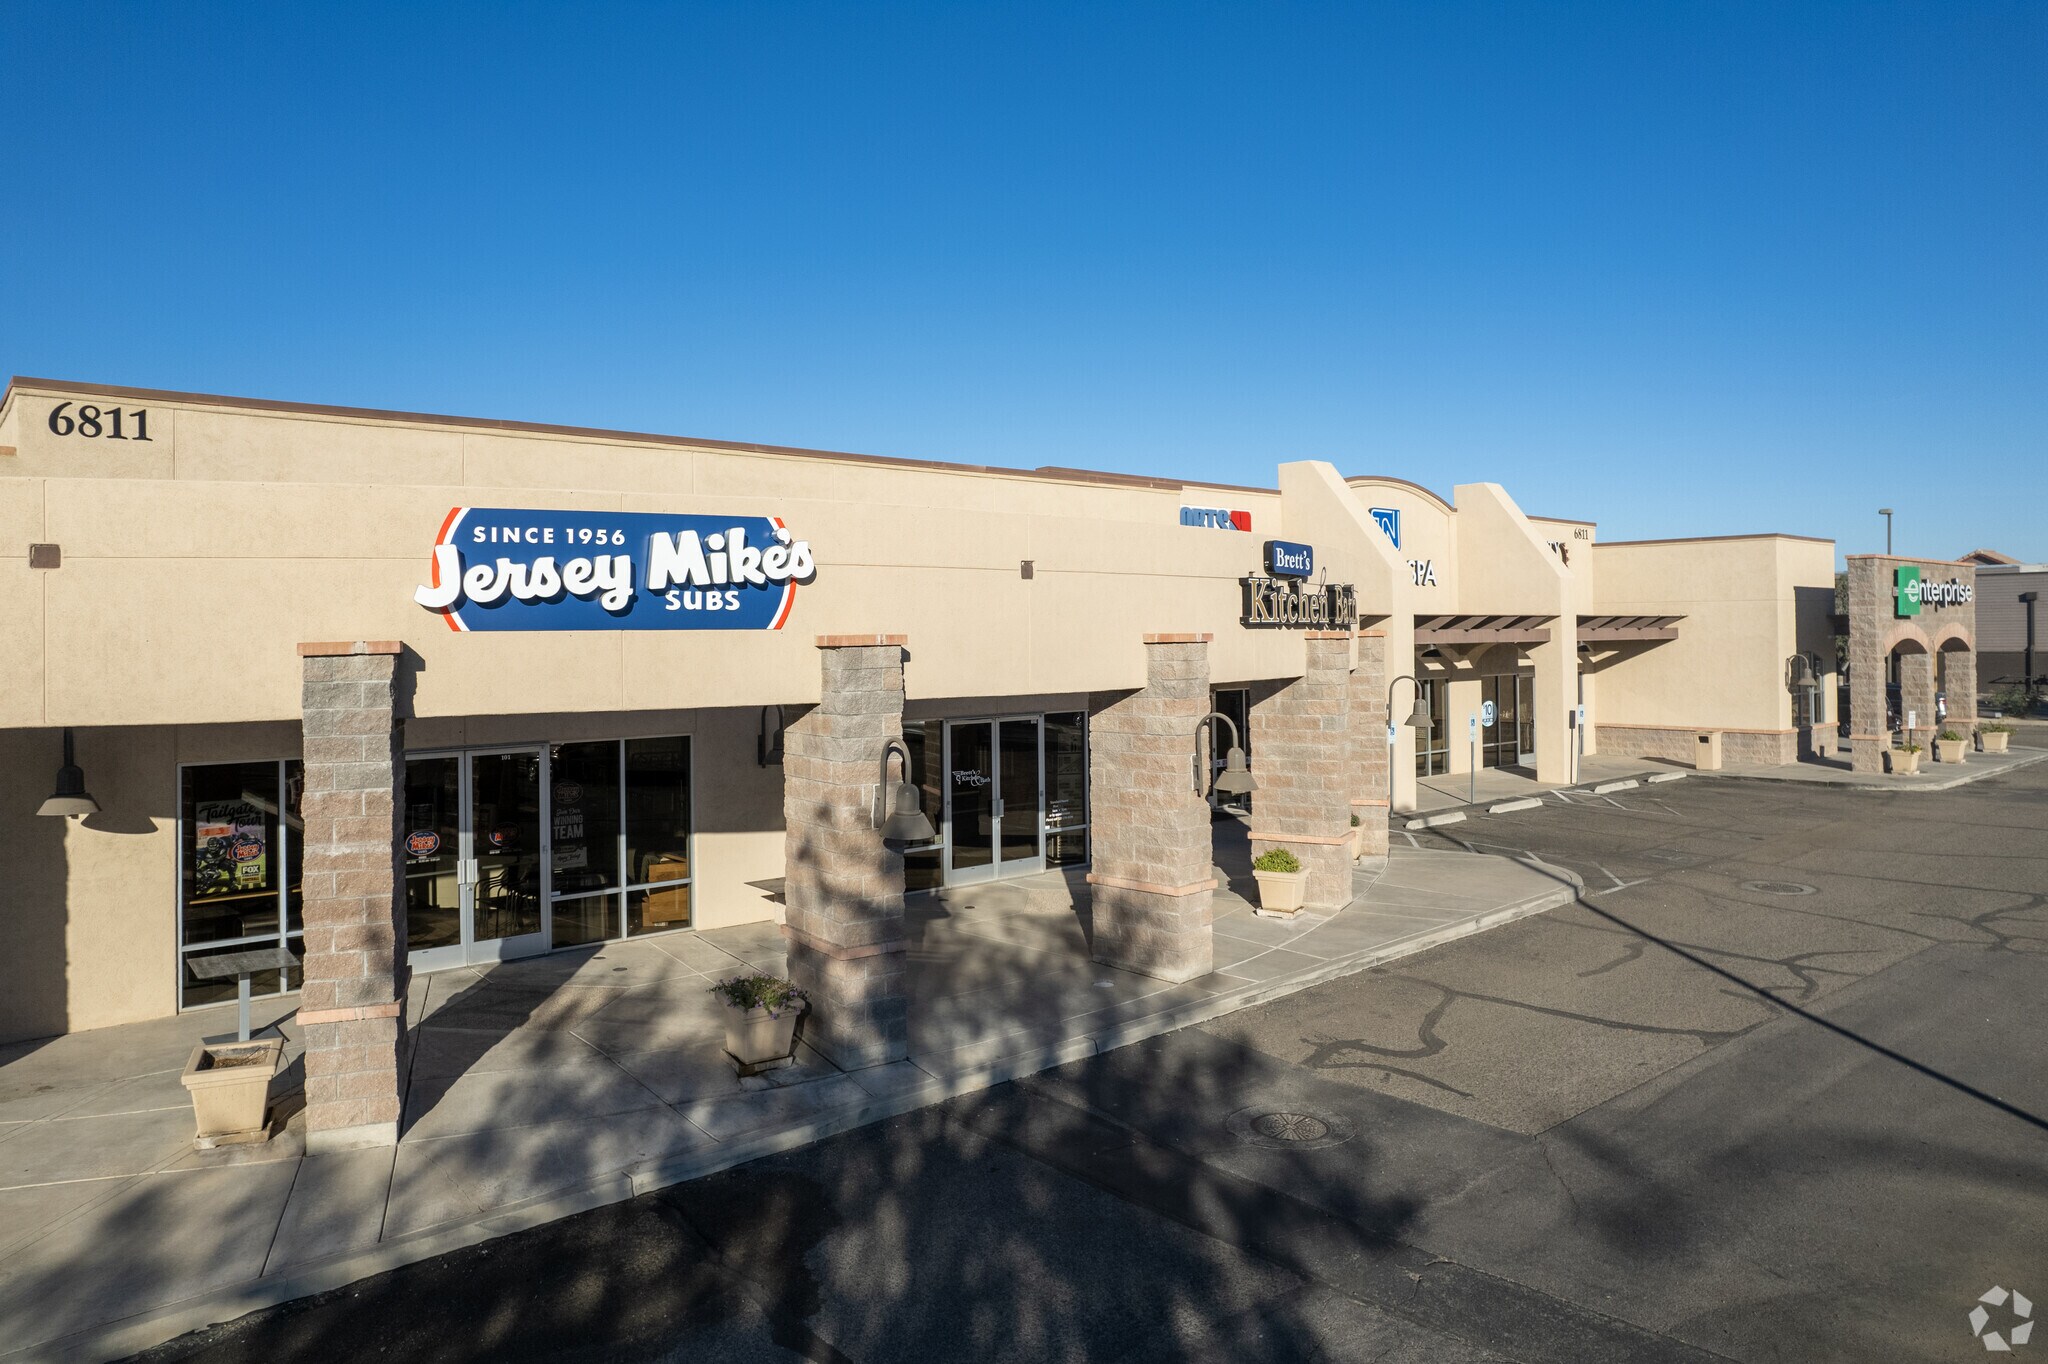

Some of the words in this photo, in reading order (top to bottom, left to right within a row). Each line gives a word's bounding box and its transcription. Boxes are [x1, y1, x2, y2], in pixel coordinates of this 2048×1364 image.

[48, 402, 153, 441] 6811
[473, 525, 554, 543] SINCE
[566, 528, 625, 546] 1956
[1574, 527, 1588, 540] 6811
[414, 544, 633, 611] Jersey
[648, 527, 816, 589] Mike's
[1276, 547, 1310, 570] Brett's
[665, 590, 741, 611] SUBS
[1249, 578, 1329, 624] Kitchen
[1335, 584, 1357, 624] Bath
[1904, 578, 1973, 608] enterprise
[199, 803, 256, 824] Tailgate
[554, 815, 583, 825] WINNING
[411, 835, 435, 844] Jersey
[554, 824, 584, 840] TEAM
[243, 866, 259, 874] FOX
